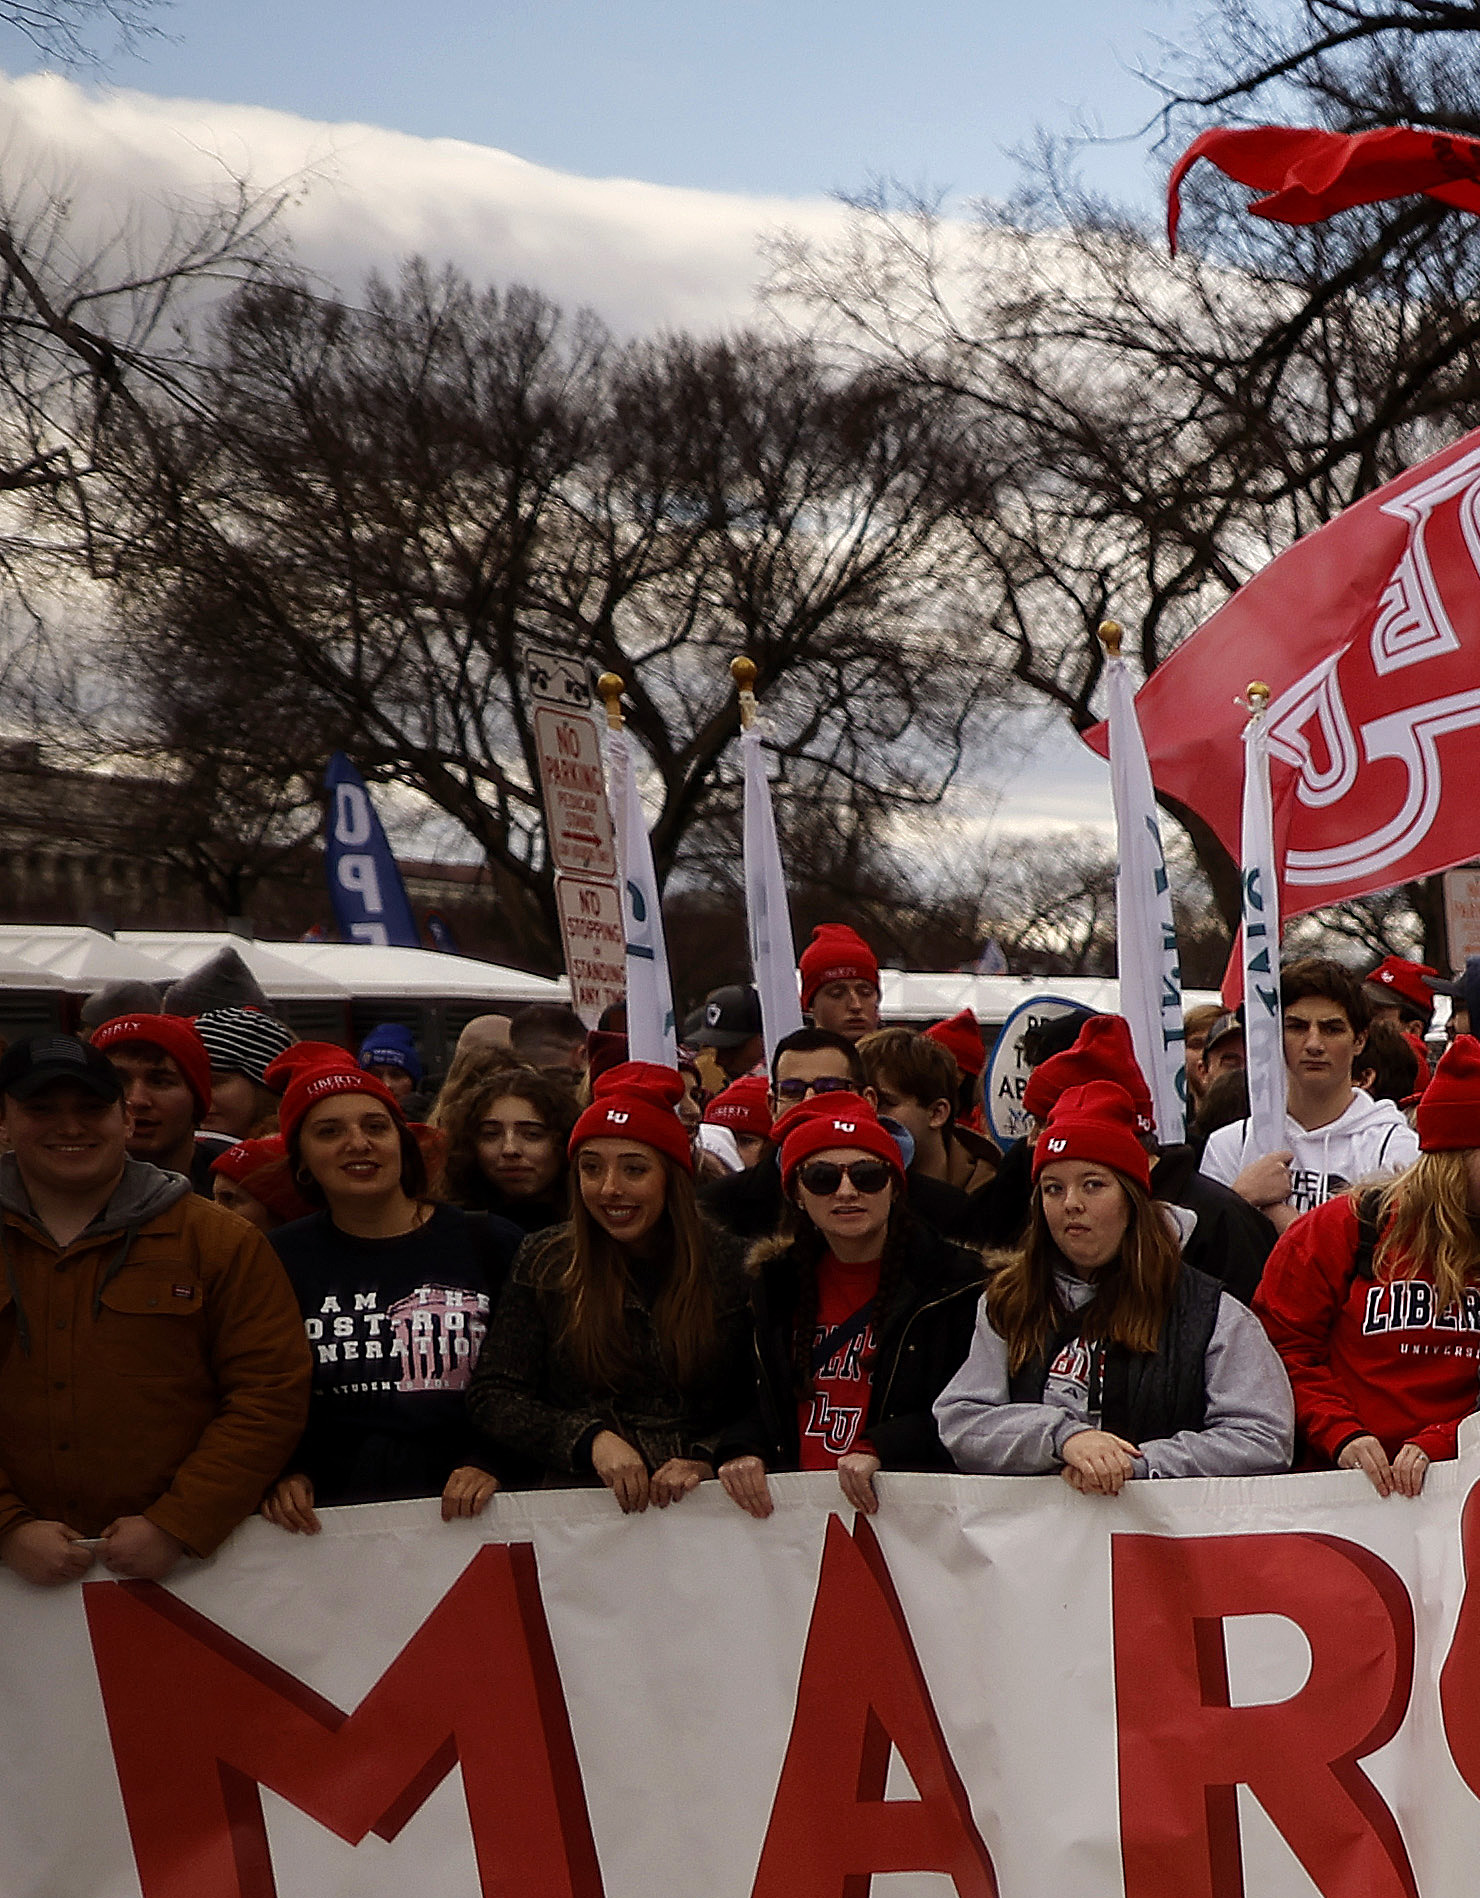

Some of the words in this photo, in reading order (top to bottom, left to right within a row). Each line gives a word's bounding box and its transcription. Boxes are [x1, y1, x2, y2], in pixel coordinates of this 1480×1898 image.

[307, 1074, 363, 1096] LIBERTY
[606, 1109, 629, 1125] LU
[833, 1120, 856, 1133] LU
[1047, 1138, 1067, 1154] LU
[320, 1291, 378, 1315] AM
[414, 1287, 491, 1315] THE
[805, 1391, 863, 1455] LU
